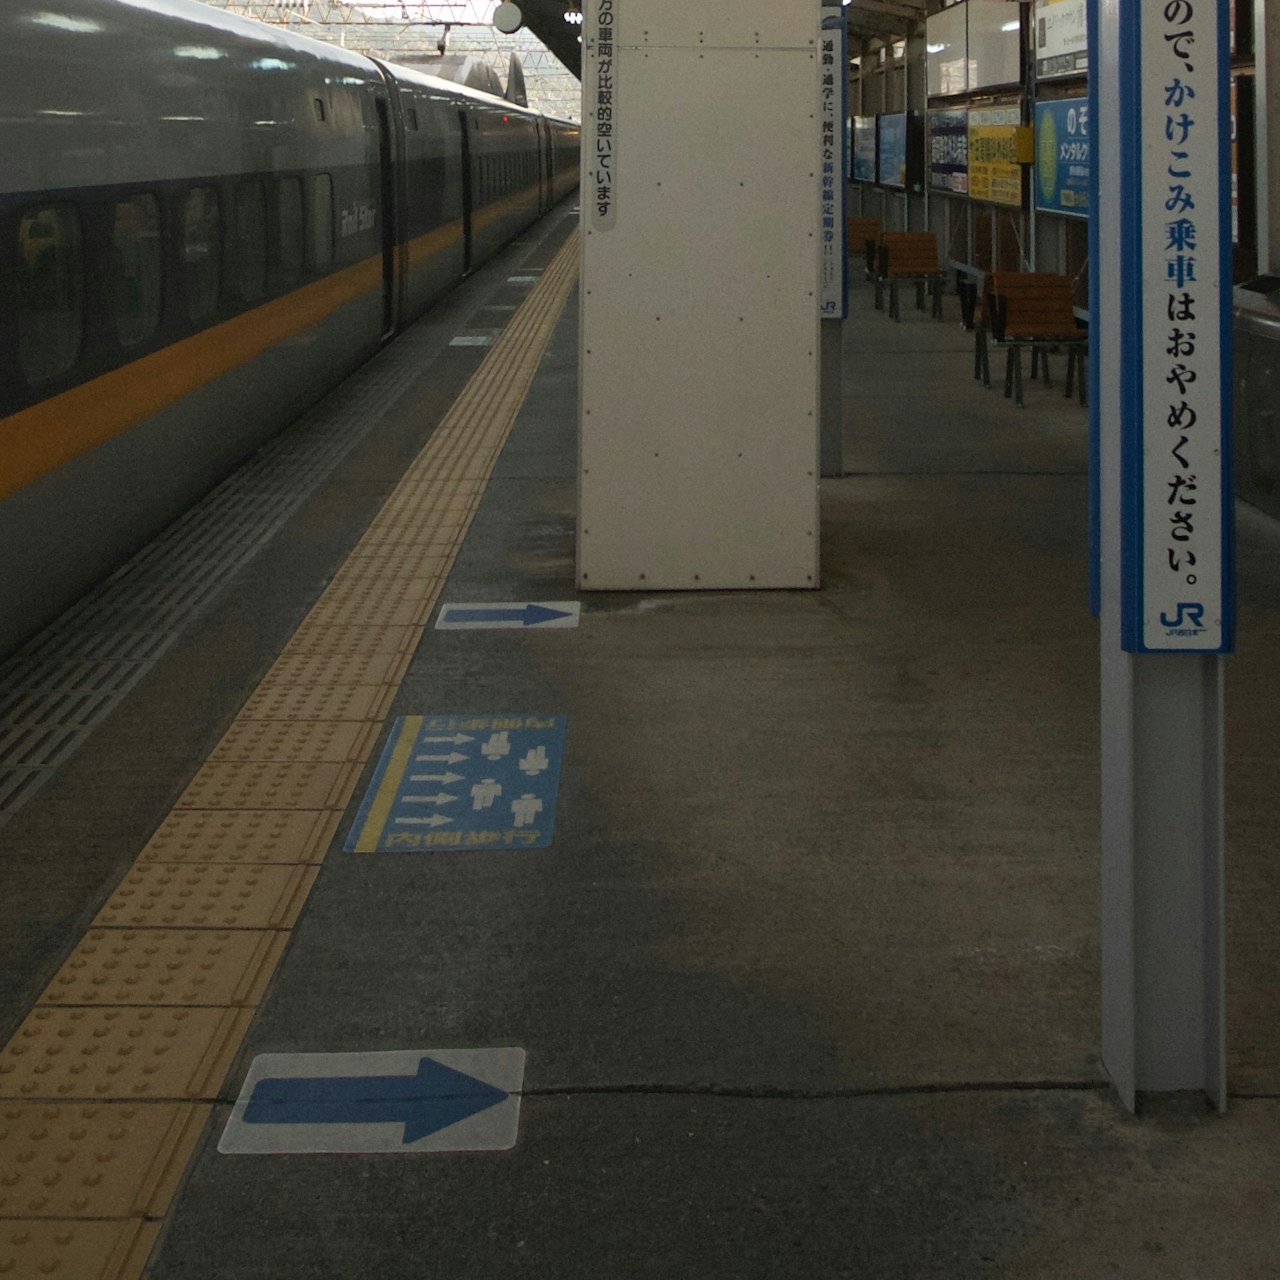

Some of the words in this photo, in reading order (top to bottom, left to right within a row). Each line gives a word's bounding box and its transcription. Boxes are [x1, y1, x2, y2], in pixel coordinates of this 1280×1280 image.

[1160, 602, 1204, 627] JR
[384, 830, 542, 847] 内側歩行
